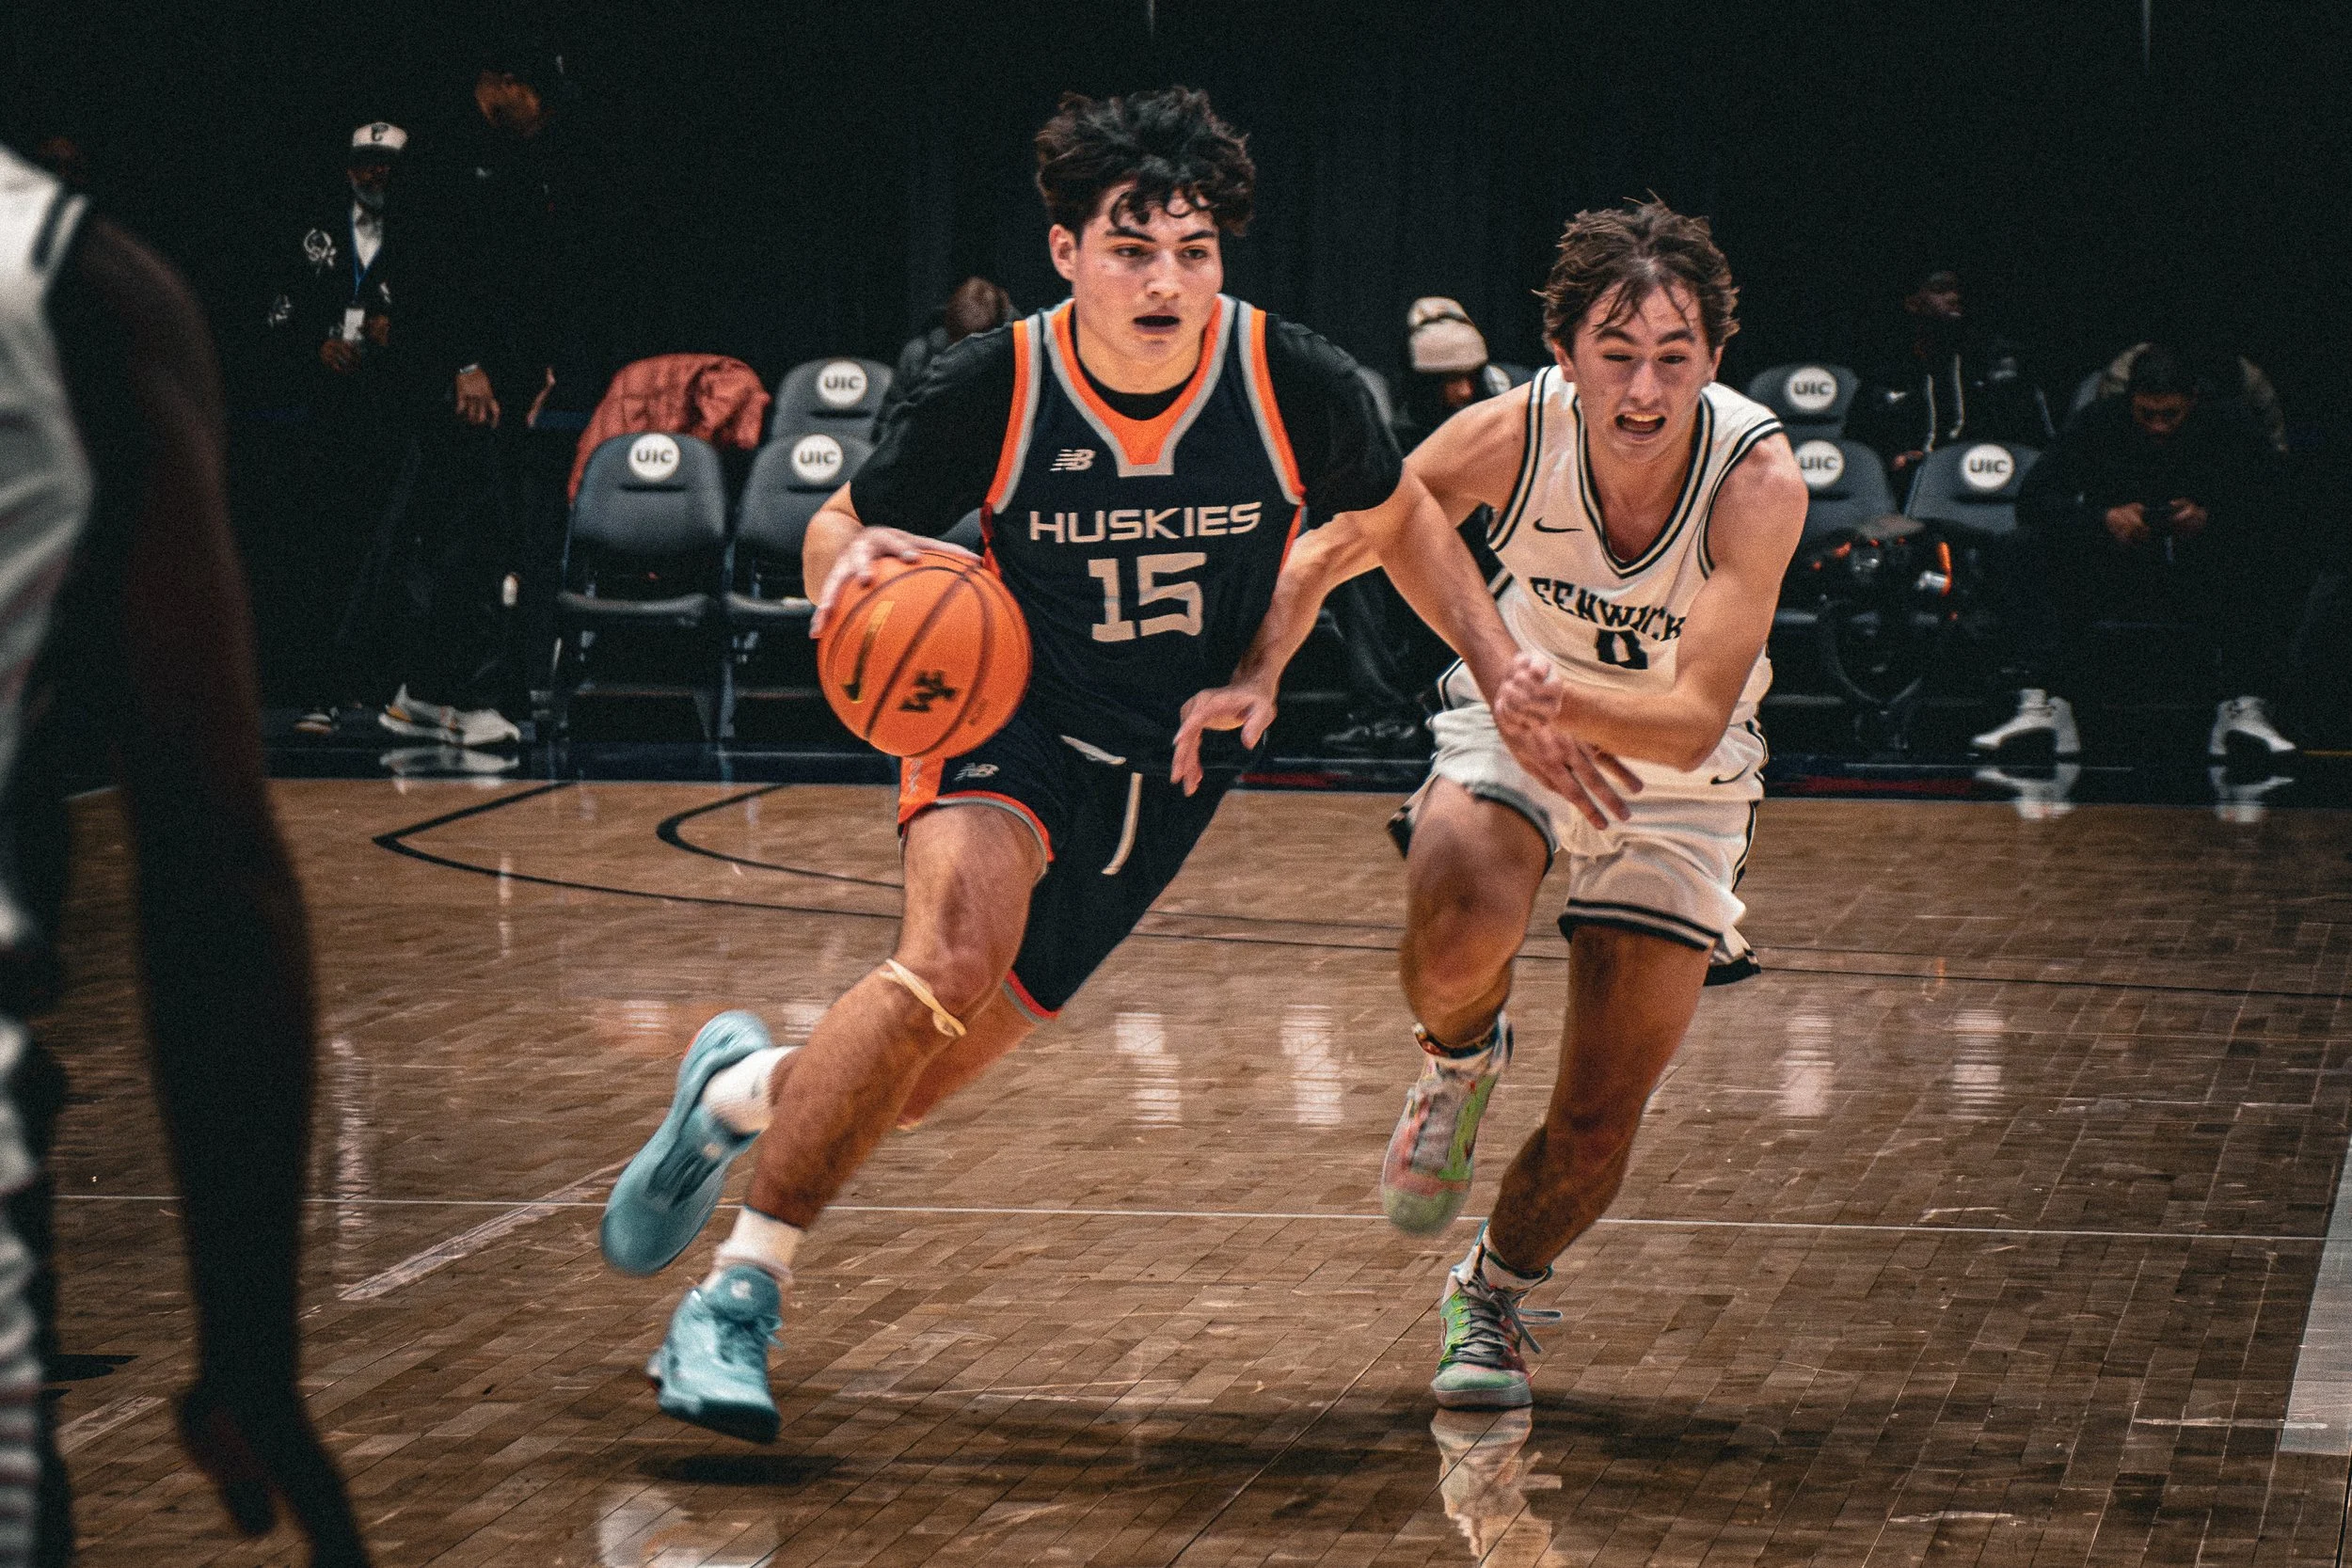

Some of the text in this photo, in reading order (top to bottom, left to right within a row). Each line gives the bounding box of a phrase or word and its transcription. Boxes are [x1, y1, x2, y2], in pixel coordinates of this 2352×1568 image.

[824, 374, 862, 390] UIC
[1793, 379, 1832, 396] UIC
[636, 448, 674, 465] UIC
[799, 450, 837, 466] UIC
[1799, 454, 1837, 471] UIC
[1968, 458, 2007, 475] UIC
[1028, 500, 1263, 544] HUSKIES
[1087, 550, 1208, 643] 15
